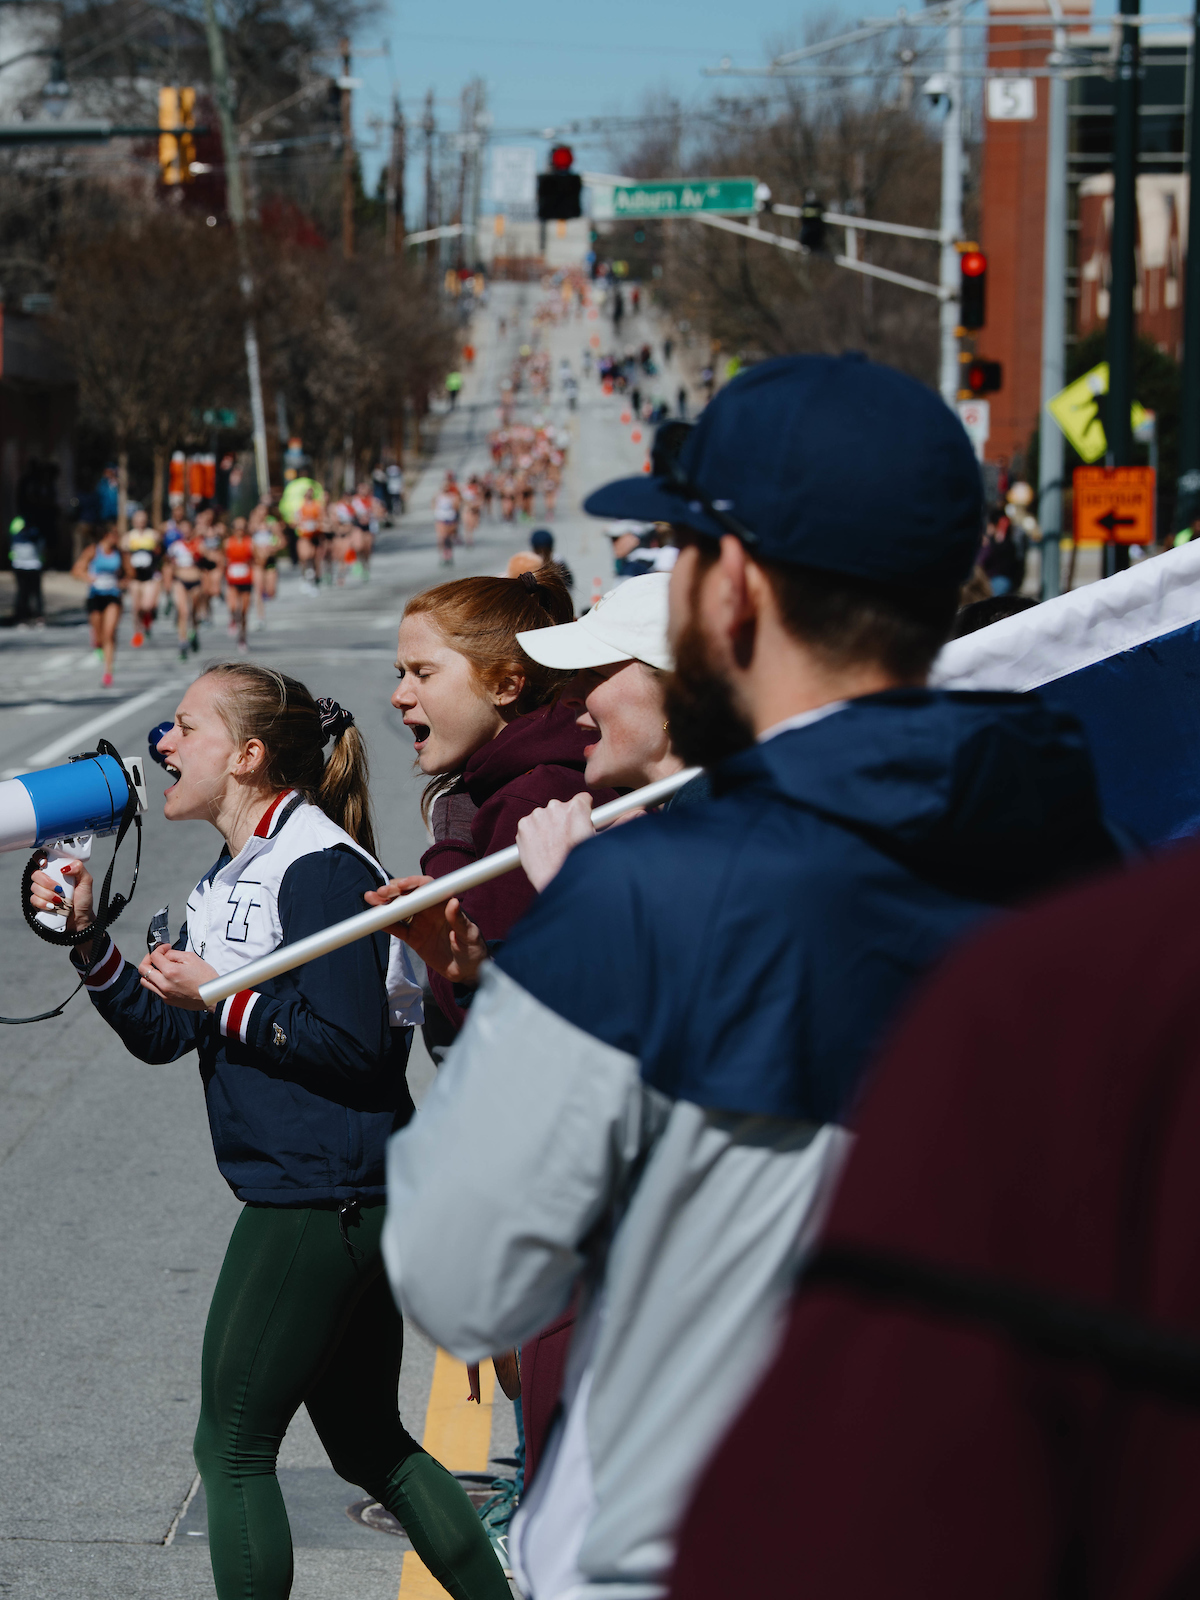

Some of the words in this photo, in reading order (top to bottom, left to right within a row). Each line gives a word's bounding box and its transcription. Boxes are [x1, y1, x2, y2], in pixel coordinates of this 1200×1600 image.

[616, 188, 678, 210] Auburn
[679, 185, 706, 209] Av
[225, 880, 262, 942] T
